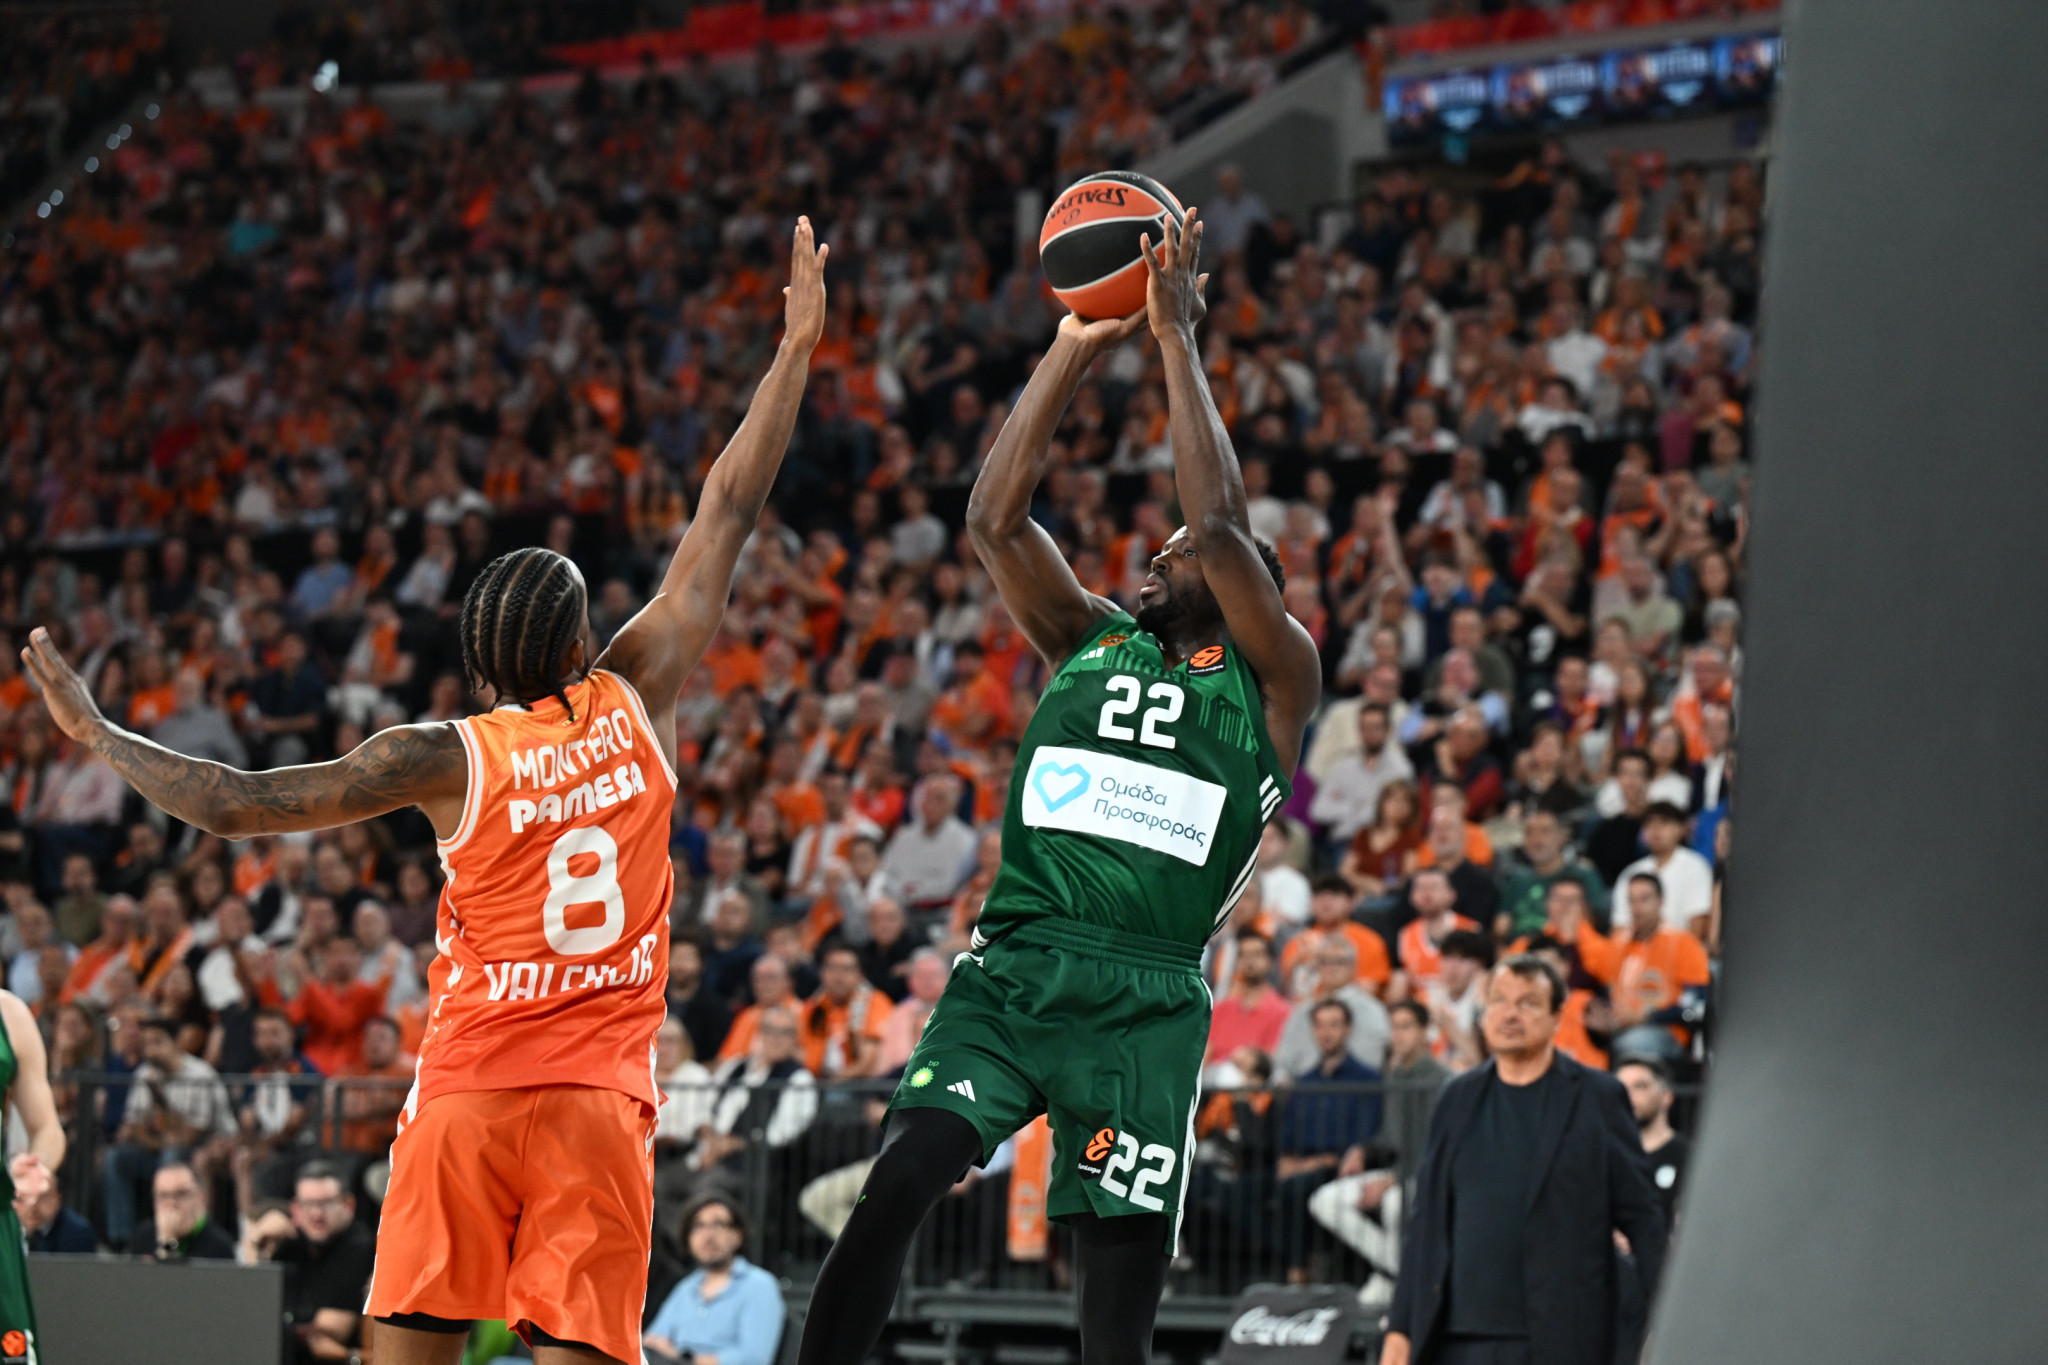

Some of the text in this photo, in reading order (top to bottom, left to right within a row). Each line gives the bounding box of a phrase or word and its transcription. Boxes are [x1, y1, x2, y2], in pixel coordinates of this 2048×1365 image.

[511, 708, 633, 789] MONTERO
[1097, 674, 1185, 750] 22
[508, 761, 648, 834] PAMESA
[1093, 798, 1207, 847] Προσφοράς
[1100, 776, 1168, 807] Ομάδα
[543, 825, 626, 956] 8
[928, 1060, 940, 1068] bp
[1100, 1130, 1176, 1211] 22
